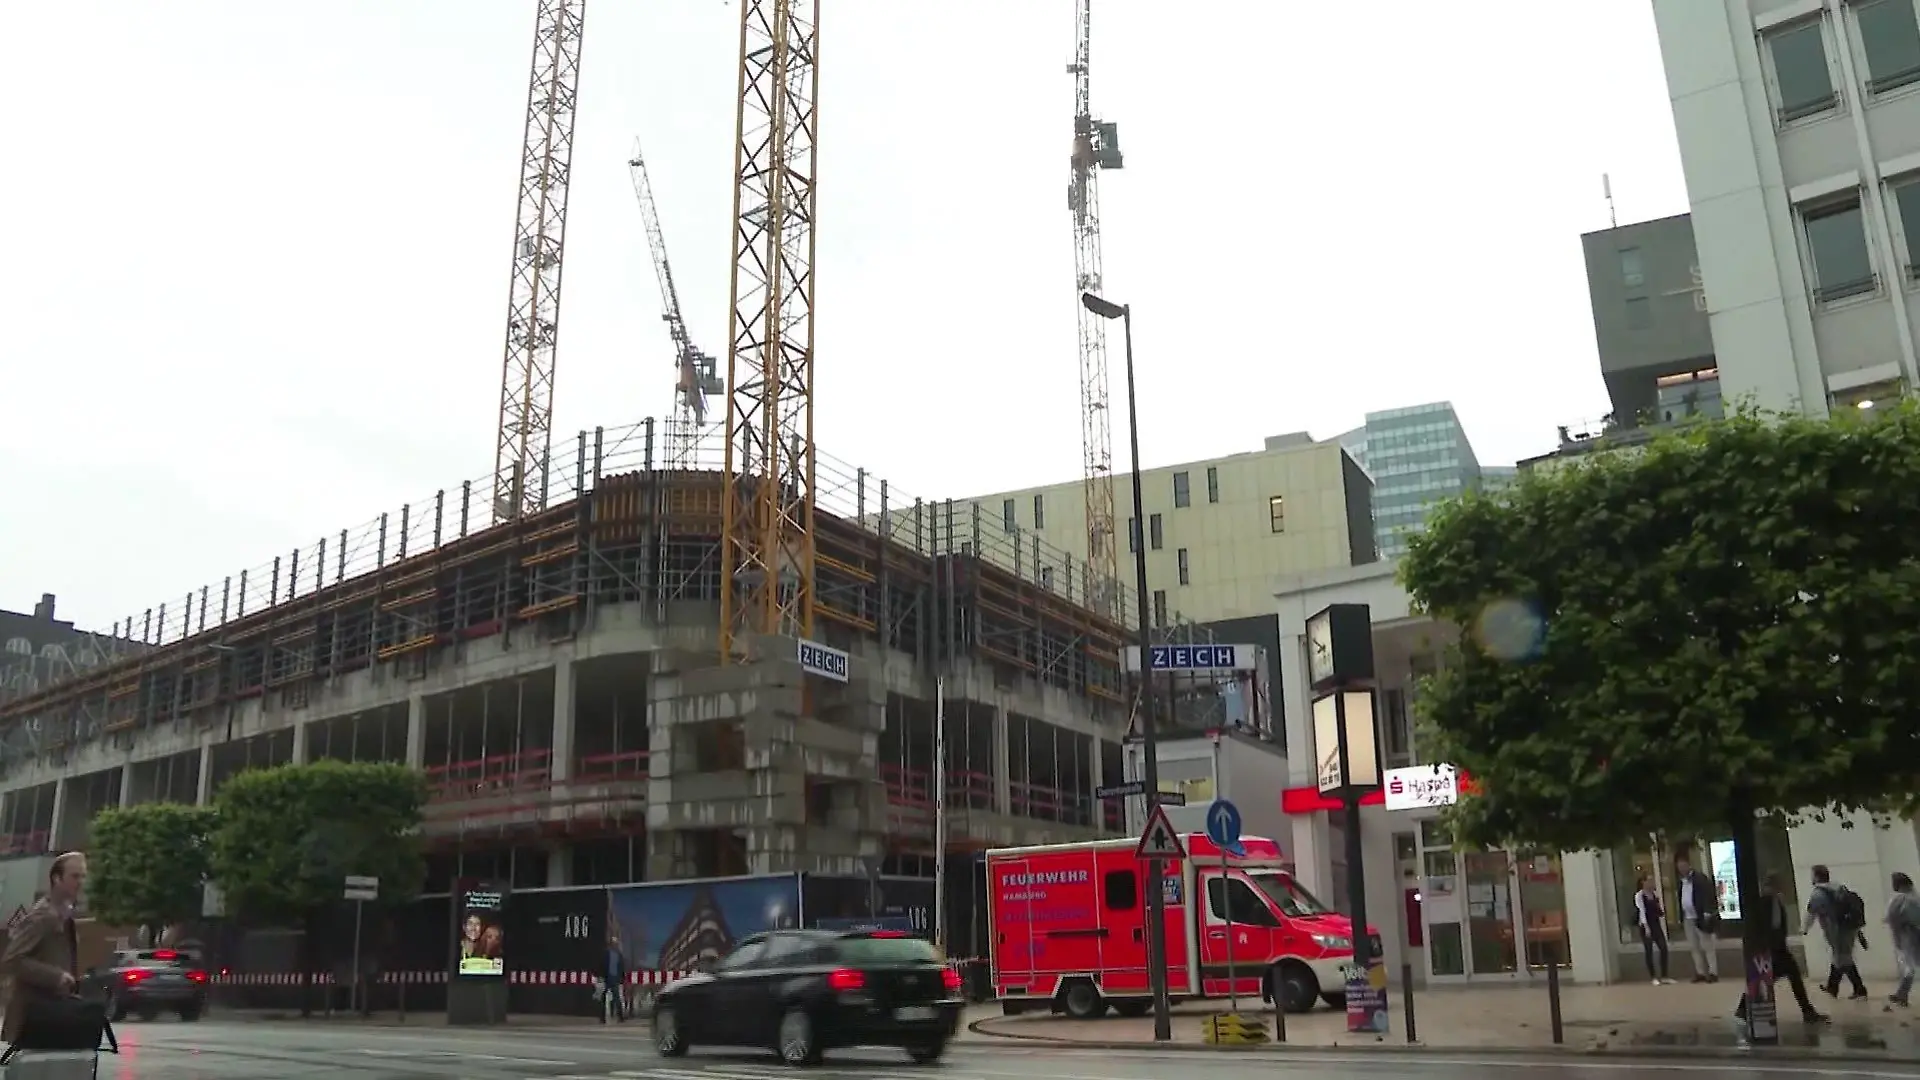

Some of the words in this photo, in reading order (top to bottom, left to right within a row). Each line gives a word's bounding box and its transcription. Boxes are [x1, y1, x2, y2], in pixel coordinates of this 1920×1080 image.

[803, 646, 845, 674] ZECH
[1153, 650, 1233, 665] ZECH
[1002, 870, 1088, 887] FEUERWEHR
[1002, 890, 1047, 901] HAMBURG
[564, 915, 589, 938] ABG
